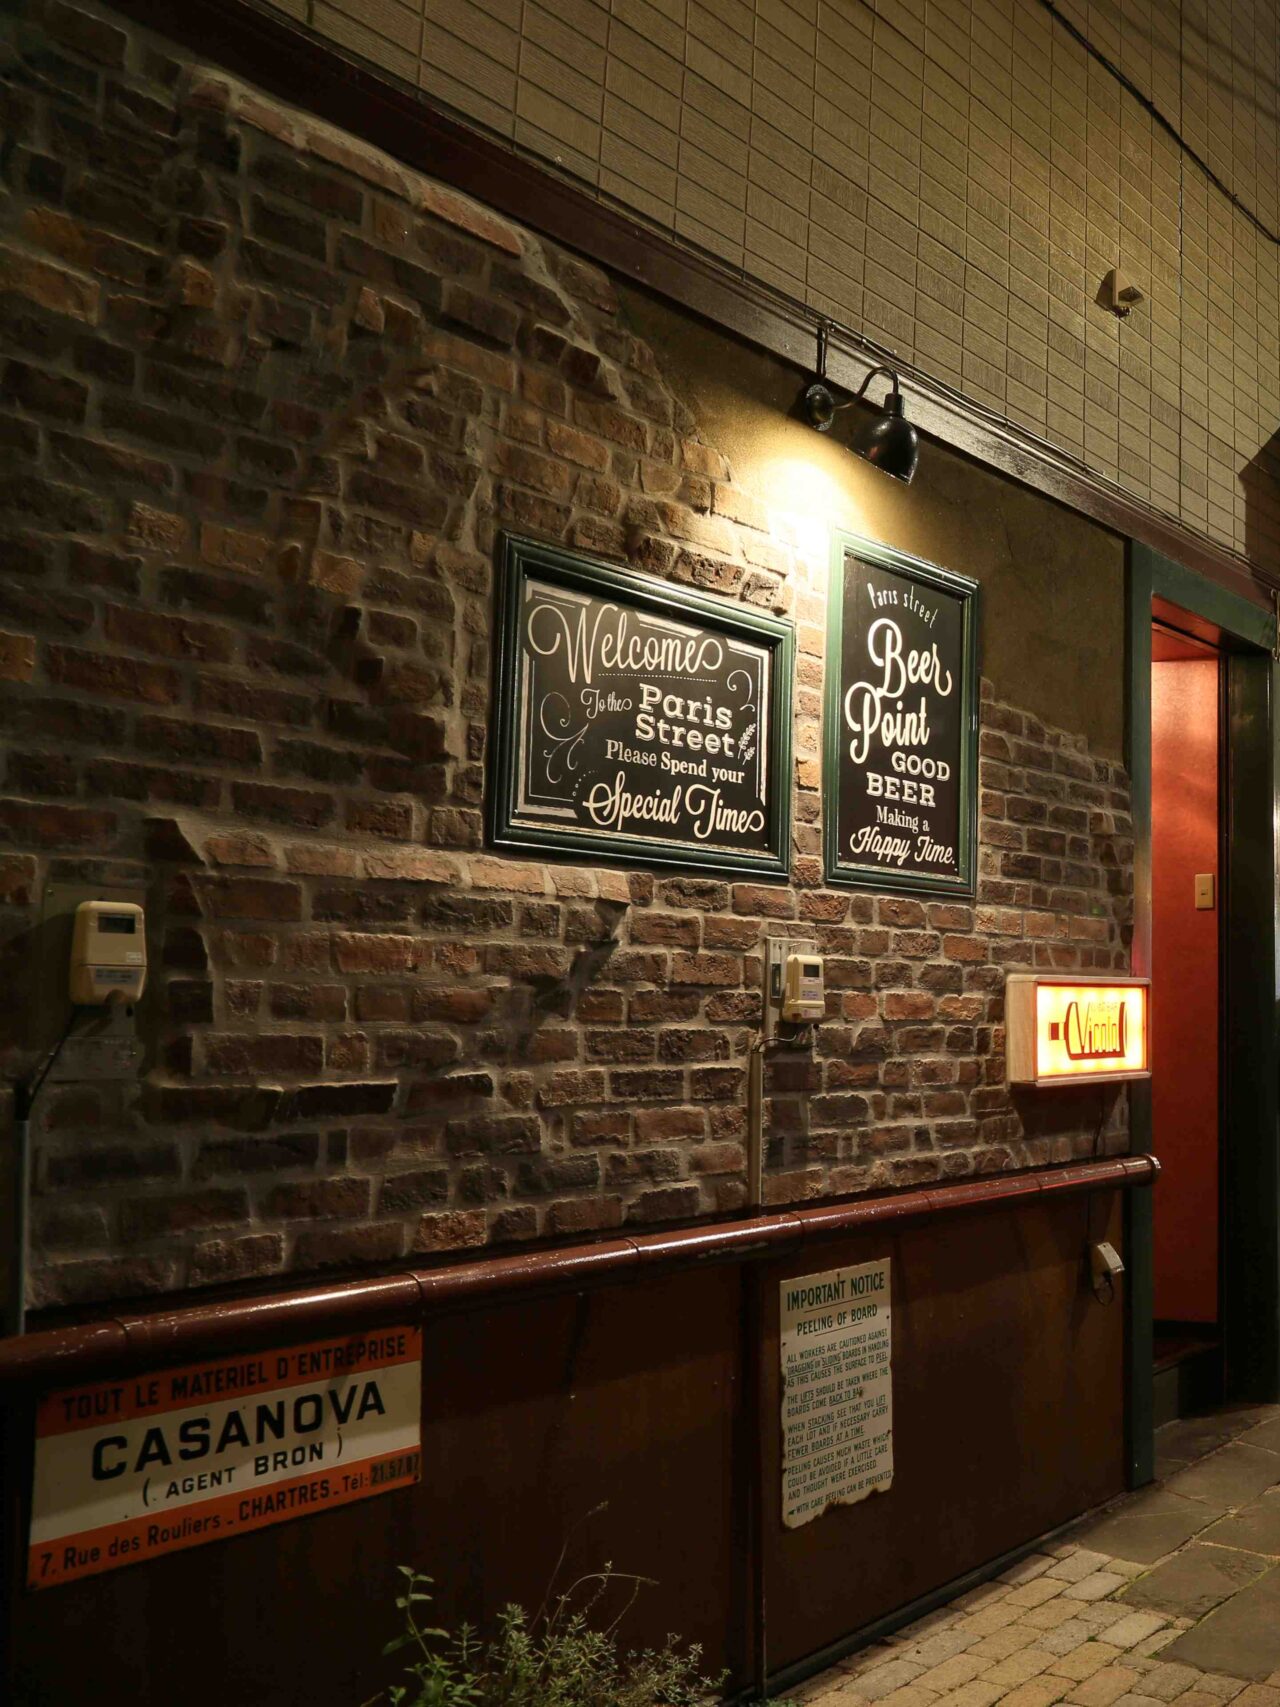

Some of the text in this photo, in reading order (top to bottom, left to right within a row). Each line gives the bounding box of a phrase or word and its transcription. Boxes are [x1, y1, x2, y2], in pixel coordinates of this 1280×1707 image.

[903, 585, 938, 629] street
[528, 604, 722, 684] Welcome
[868, 618, 952, 698] Beer
[581, 688, 632, 720] To the
[638, 682, 733, 731] Paris
[845, 681, 930, 764] Point
[635, 712, 735, 758] Street
[605, 739, 745, 785] Please Spend your
[891, 751, 951, 782] GOOD
[582, 771, 765, 839] Special Time
[866, 771, 936, 808] BEER
[876, 804, 930, 834] Making a
[850, 826, 911, 866] Happy
[787, 1271, 884, 1310] IMPORTANT NOTICE
[797, 1314, 832, 1336] PEELING
[851, 1303, 877, 1322] BOARD
[786, 1328, 887, 1363] ALL WORKERS ARE CAUTIONED AGAINST
[842, 1346, 860, 1360] BOARDS
[867, 1339, 888, 1353] HANDLING
[63, 1335, 406, 1422] TOUT LE MATERIEL D'ENTREPRISE
[786, 1393, 797, 1405] THE
[800, 1388, 814, 1401] LIFTS
[815, 1382, 835, 1397] SHOULD
[845, 1375, 859, 1388] TAKEN
[861, 1369, 877, 1383] WHERE
[878, 1366, 888, 1378] THE
[797, 1373, 808, 1385] THIS
[810, 1367, 831, 1381] CAUSES
[833, 1363, 843, 1375] THE
[845, 1357, 866, 1371] SURFACE
[876, 1351, 887, 1362] PEEL
[786, 1402, 809, 1417] BOARDS
[811, 1397, 826, 1410] COME
[828, 1392, 842, 1405] BACK
[787, 1395, 885, 1434] WHEN STACKING SEE THAT YOU LIFT
[92, 1380, 386, 1482] CASANOVA
[787, 1433, 803, 1447] EACH
[806, 1429, 816, 1440] LOT
[818, 1424, 830, 1436] AND
[840, 1411, 869, 1429] NECESSARY
[872, 1405, 888, 1419] CARRY
[787, 1443, 808, 1459] FEWER
[811, 1435, 833, 1451] BOARDS
[850, 1425, 864, 1438] TIME
[787, 1472, 806, 1488] COULD
[818, 1460, 841, 1477] AVOIDED
[856, 1449, 872, 1464] LITTLE
[874, 1444, 888, 1457] CARE
[788, 1432, 888, 1476] PEELING CAUSES MUCH WASTE WHICH
[788, 1459, 876, 1500] AND THOUGHT WERE EXERCISED
[795, 1500, 809, 1514] WITH
[810, 1495, 823, 1508] CARE
[825, 1487, 845, 1503] PEELING
[846, 1482, 856, 1494] CAN
[865, 1469, 891, 1487] PREVENTED
[63, 1545, 101, 1569] Rue
[108, 1535, 140, 1558] des
[147, 1512, 222, 1546] Rouliers
[239, 1478, 330, 1522] CHARTRES
